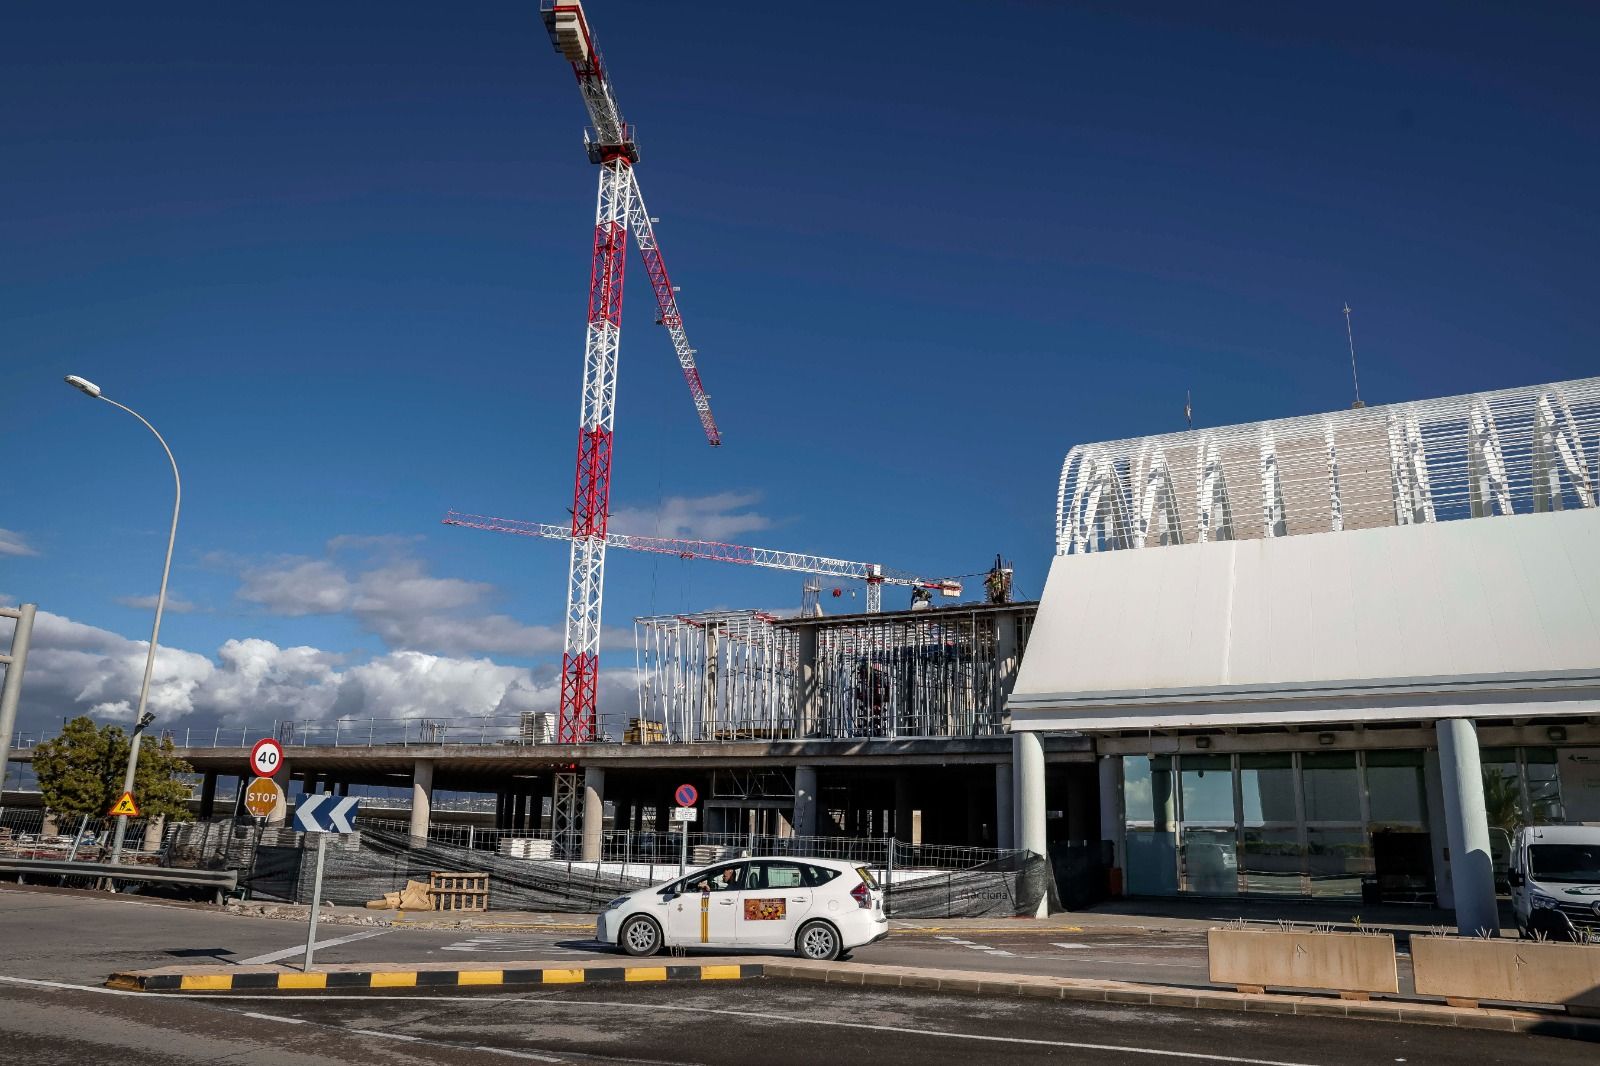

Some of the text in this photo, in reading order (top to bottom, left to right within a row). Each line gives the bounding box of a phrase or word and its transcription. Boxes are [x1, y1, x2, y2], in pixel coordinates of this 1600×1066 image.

[258, 751, 277, 765] 40
[248, 792, 277, 803] STOP
[970, 889, 1008, 900] acciona
